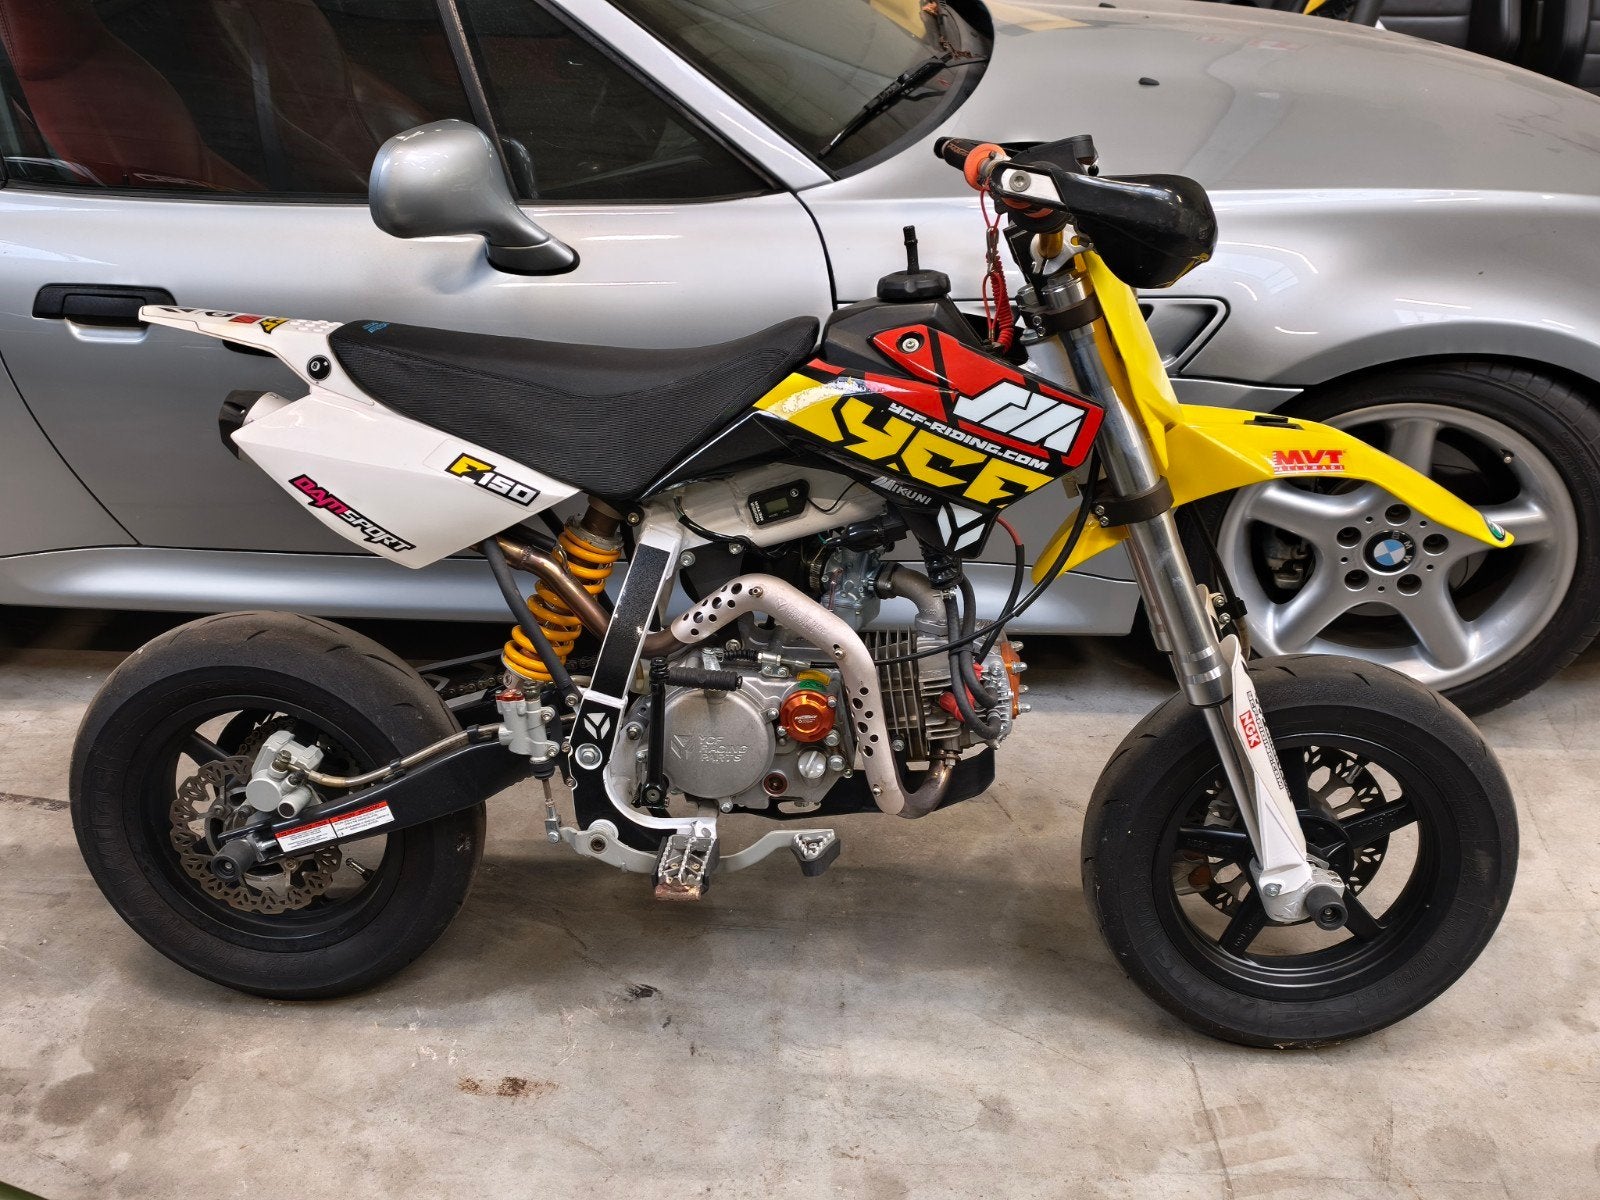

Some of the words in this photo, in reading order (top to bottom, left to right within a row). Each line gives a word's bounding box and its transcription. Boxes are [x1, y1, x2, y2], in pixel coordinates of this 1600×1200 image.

[888, 402, 1049, 471] YCF-RIDING.COM
[841, 397, 1055, 505] YCF
[1273, 450, 1344, 465] MVT
[444, 452, 541, 507] F150
[699, 735, 725, 745] YCF
[1240, 710, 1261, 749] NGK
[700, 745, 749, 753] RACING
[701, 754, 742, 762] PARTS
